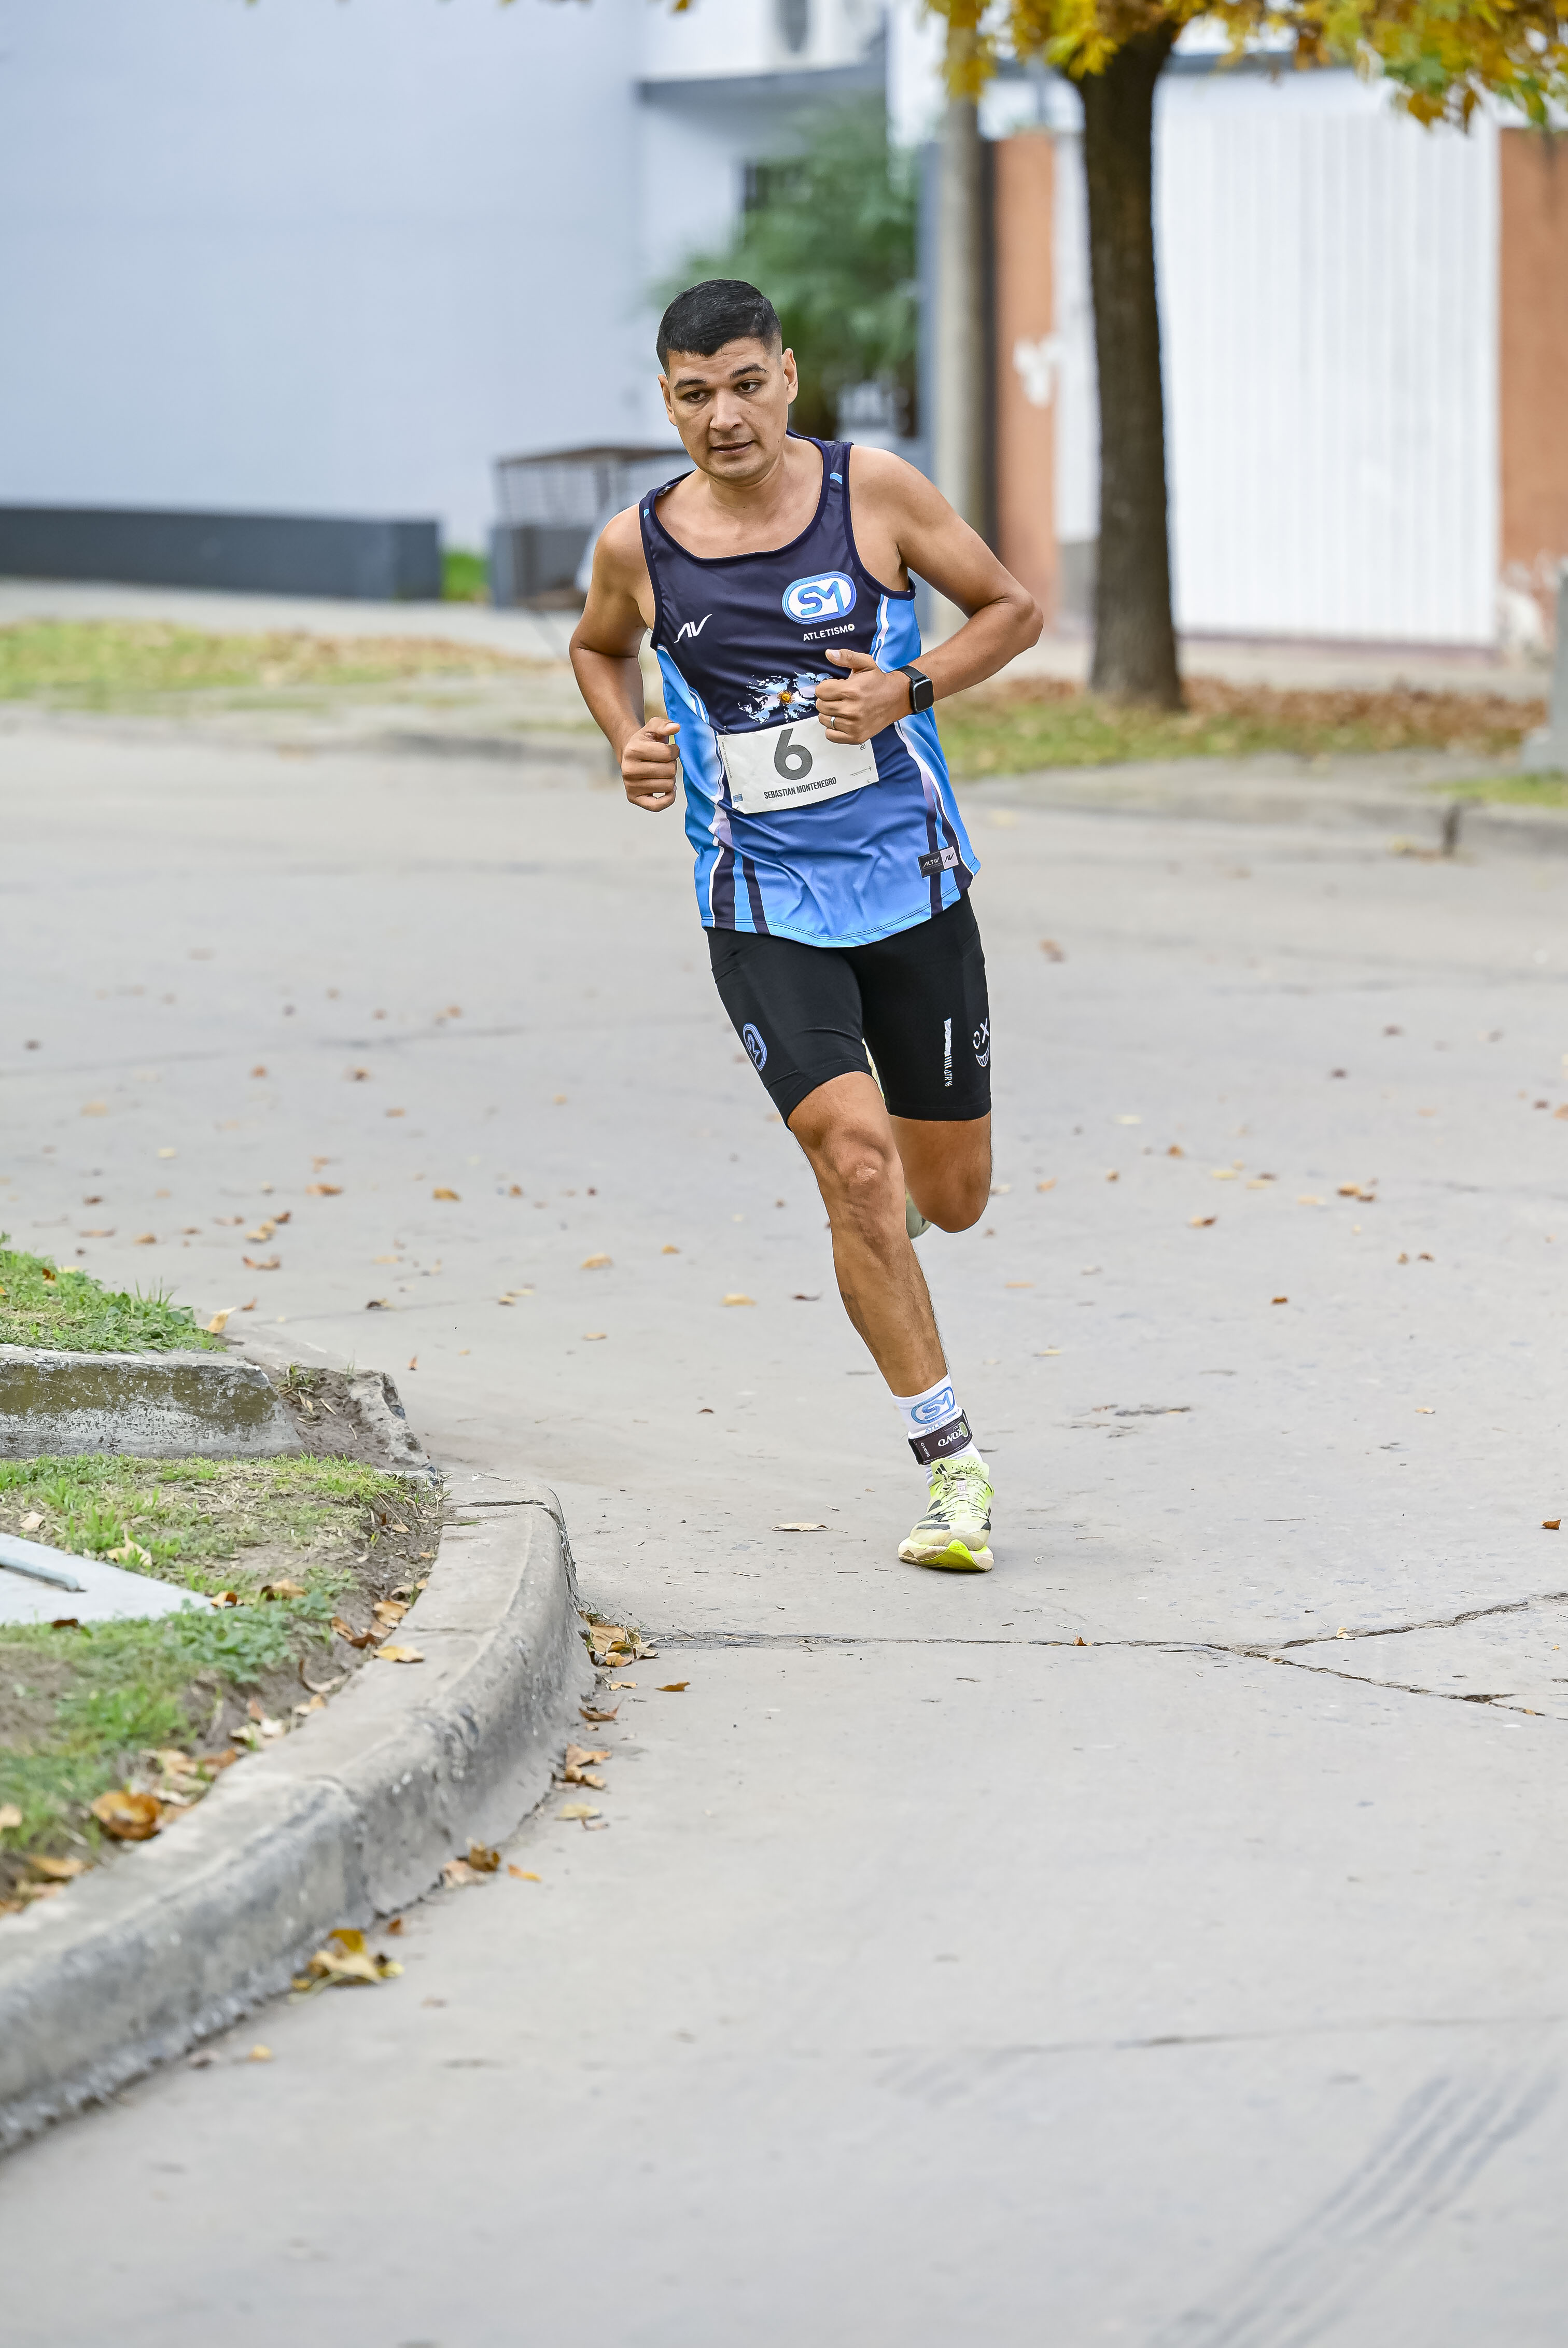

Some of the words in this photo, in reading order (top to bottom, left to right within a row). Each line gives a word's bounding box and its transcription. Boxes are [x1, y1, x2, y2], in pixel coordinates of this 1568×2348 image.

[797, 581, 846, 616] SM
[803, 623, 855, 641] ATLETISMO
[774, 728, 813, 780] 6
[763, 787, 796, 799] SEBASTIAN
[796, 777, 837, 794] MONTENEGRO
[921, 1392, 953, 1420] SM
